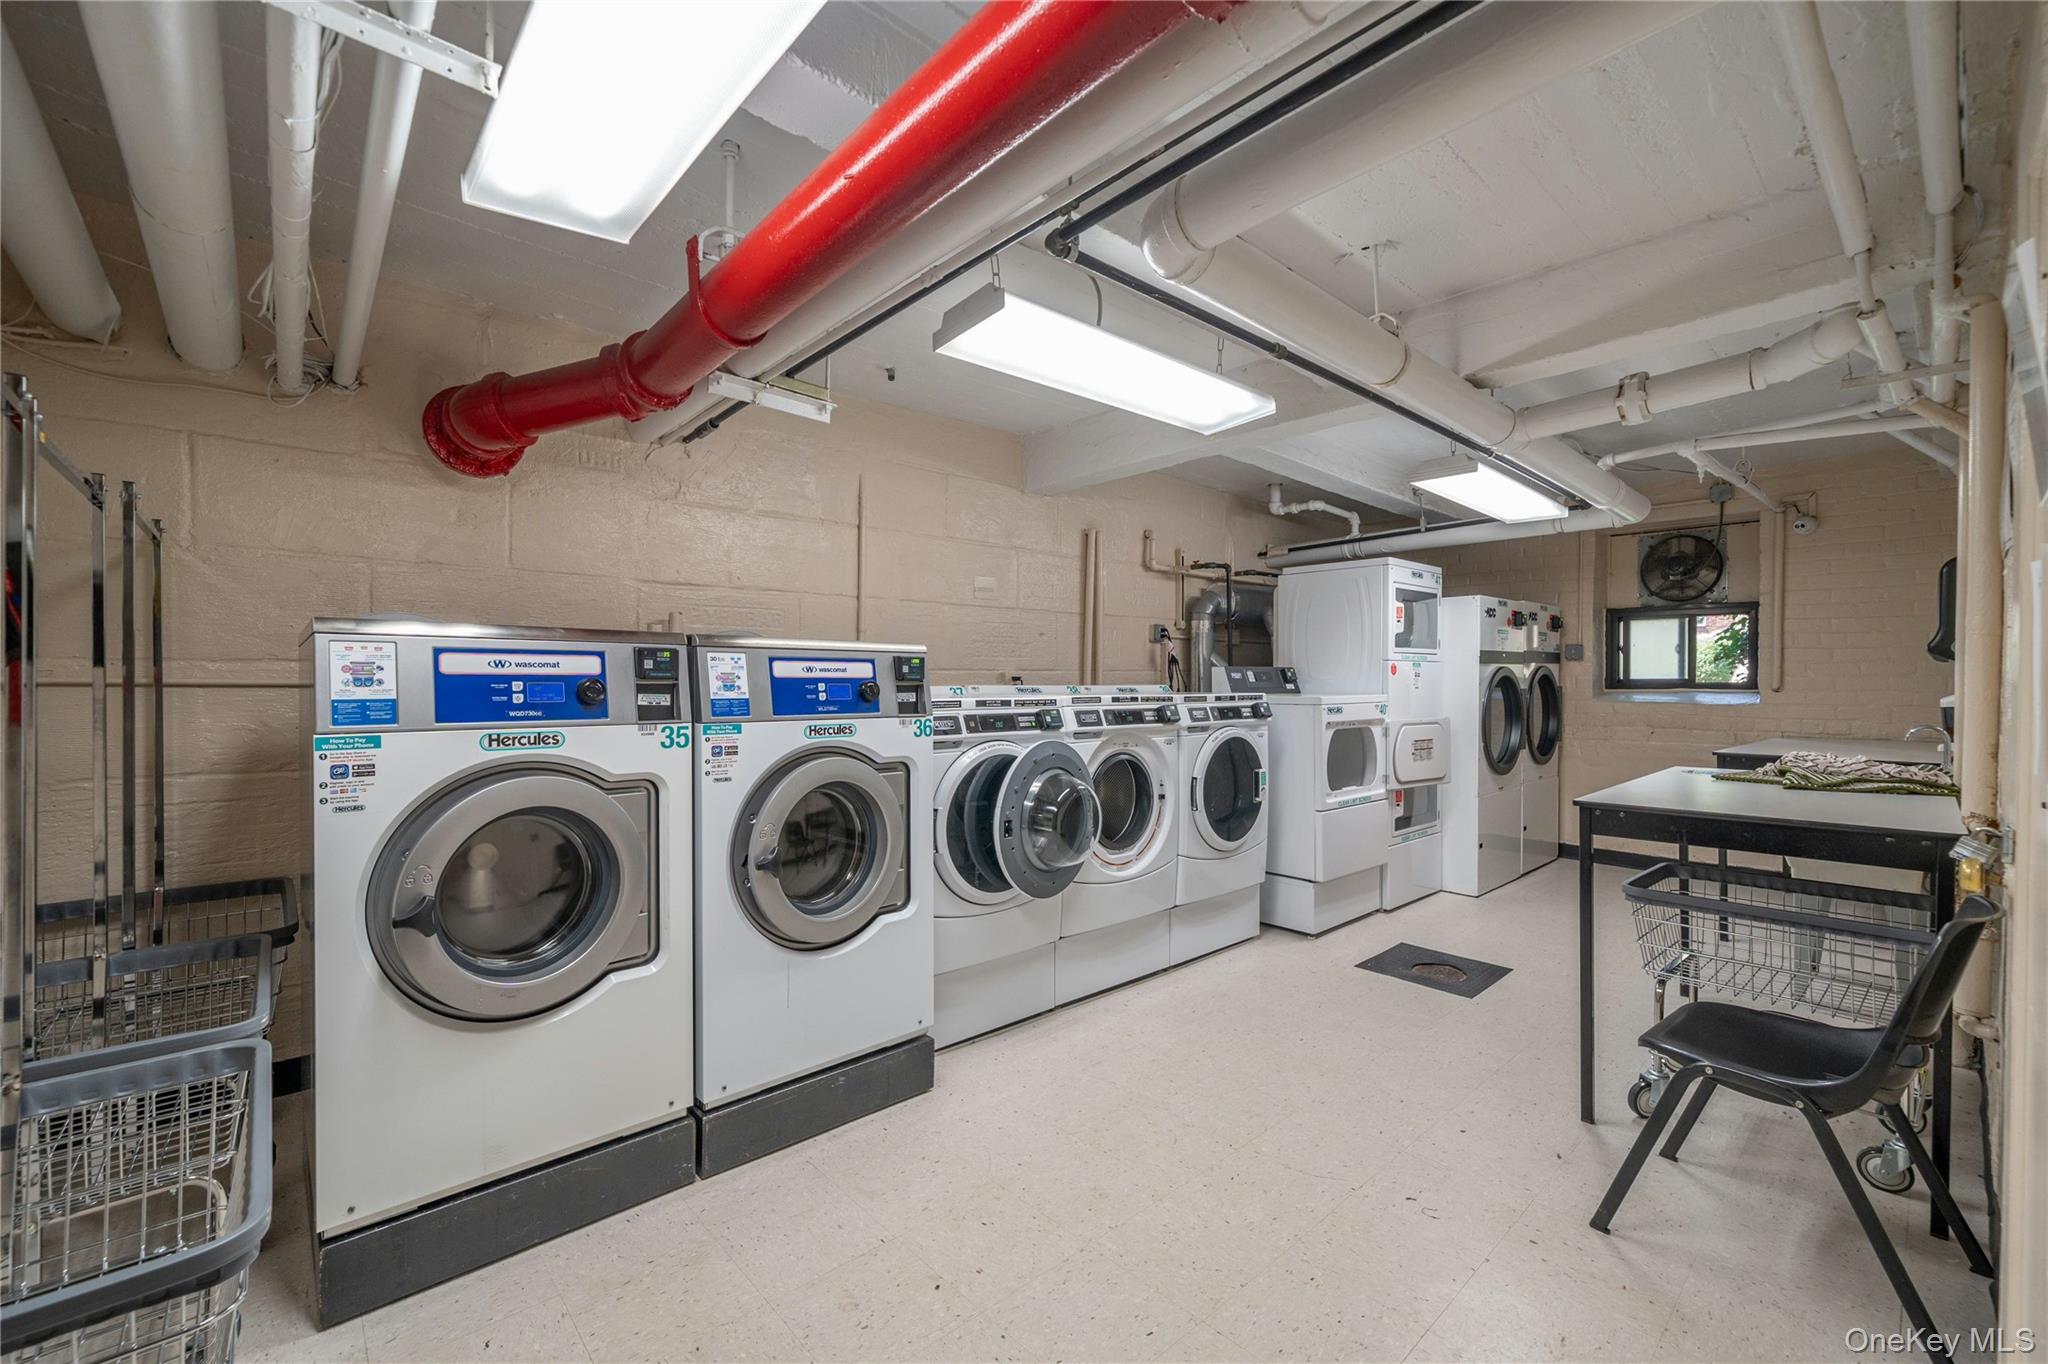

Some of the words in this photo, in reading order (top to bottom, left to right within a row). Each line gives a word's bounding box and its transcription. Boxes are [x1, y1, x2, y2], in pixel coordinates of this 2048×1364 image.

[515, 661, 560, 669] wascomat
[808, 724, 853, 737] Hercules
[913, 718, 933, 738] 36
[487, 732, 560, 748] Hercules
[659, 725, 690, 749] 35
